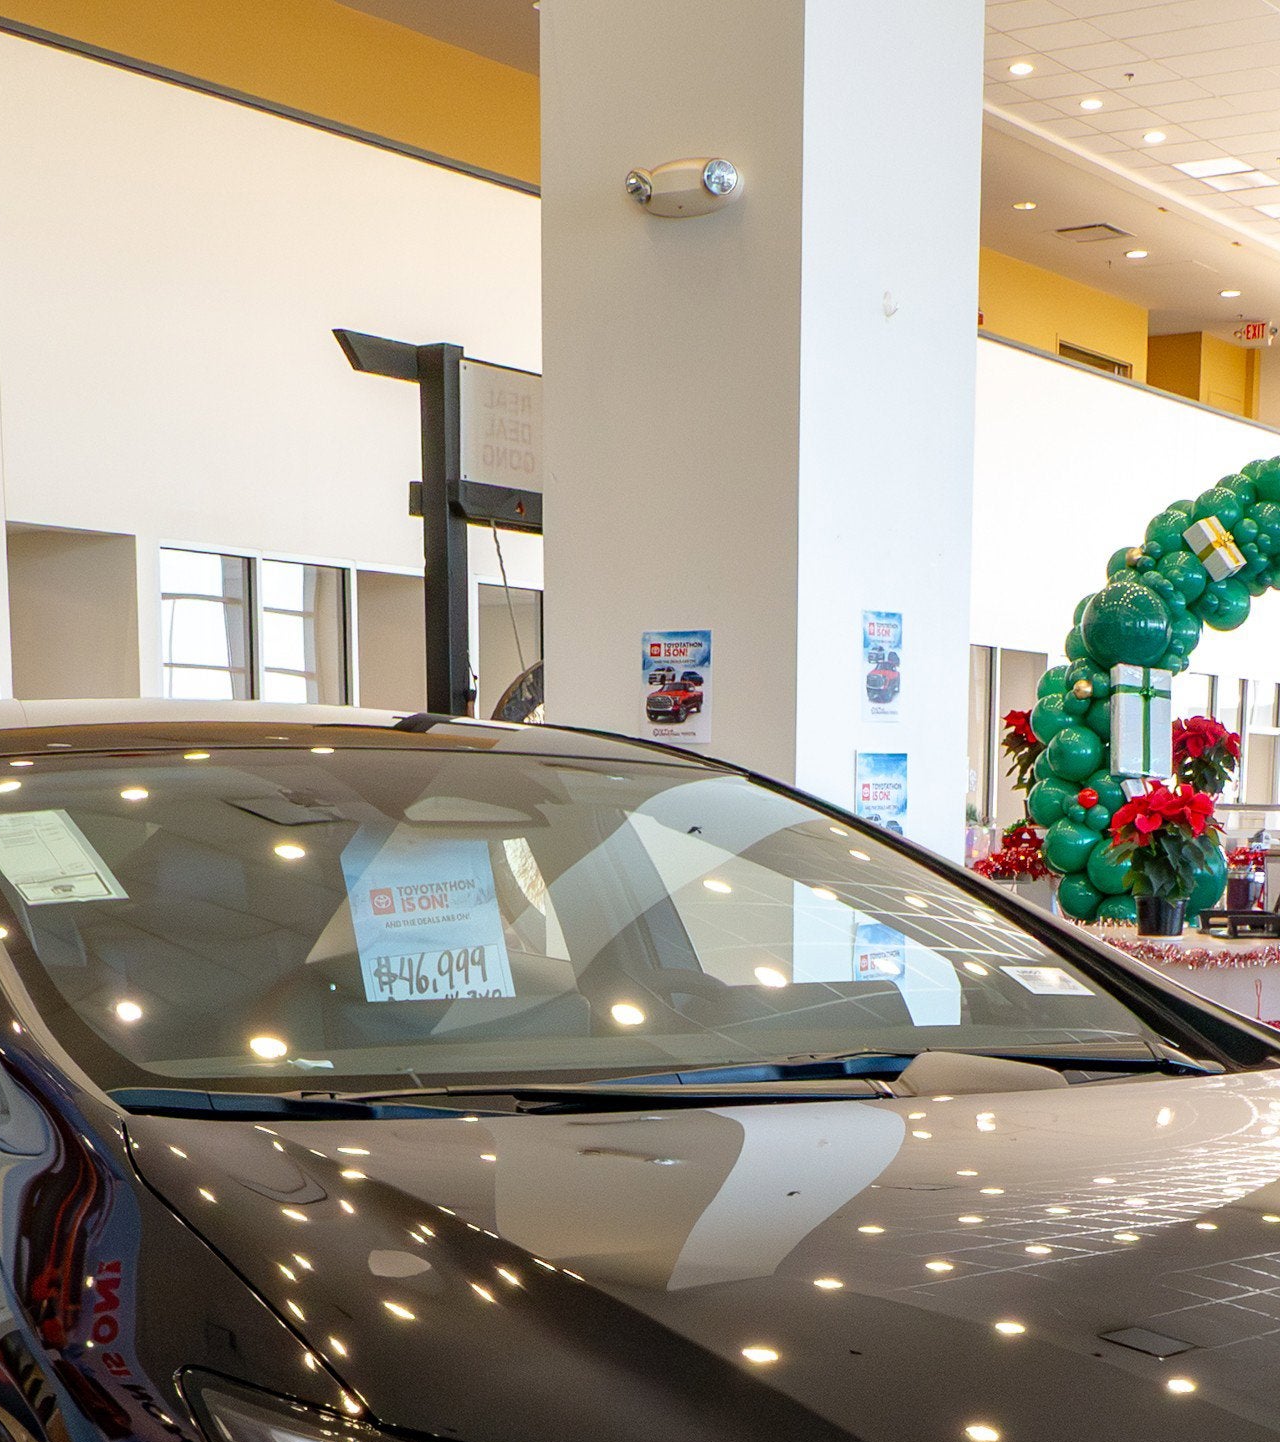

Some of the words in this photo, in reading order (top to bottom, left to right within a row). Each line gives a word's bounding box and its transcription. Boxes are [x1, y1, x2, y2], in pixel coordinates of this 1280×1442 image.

[1246, 323, 1266, 340] EXIT
[397, 879, 476, 897] TOYOTATHON
[401, 896, 416, 913] IS
[418, 893, 449, 912] ON!
[373, 945, 488, 996] $46,999
